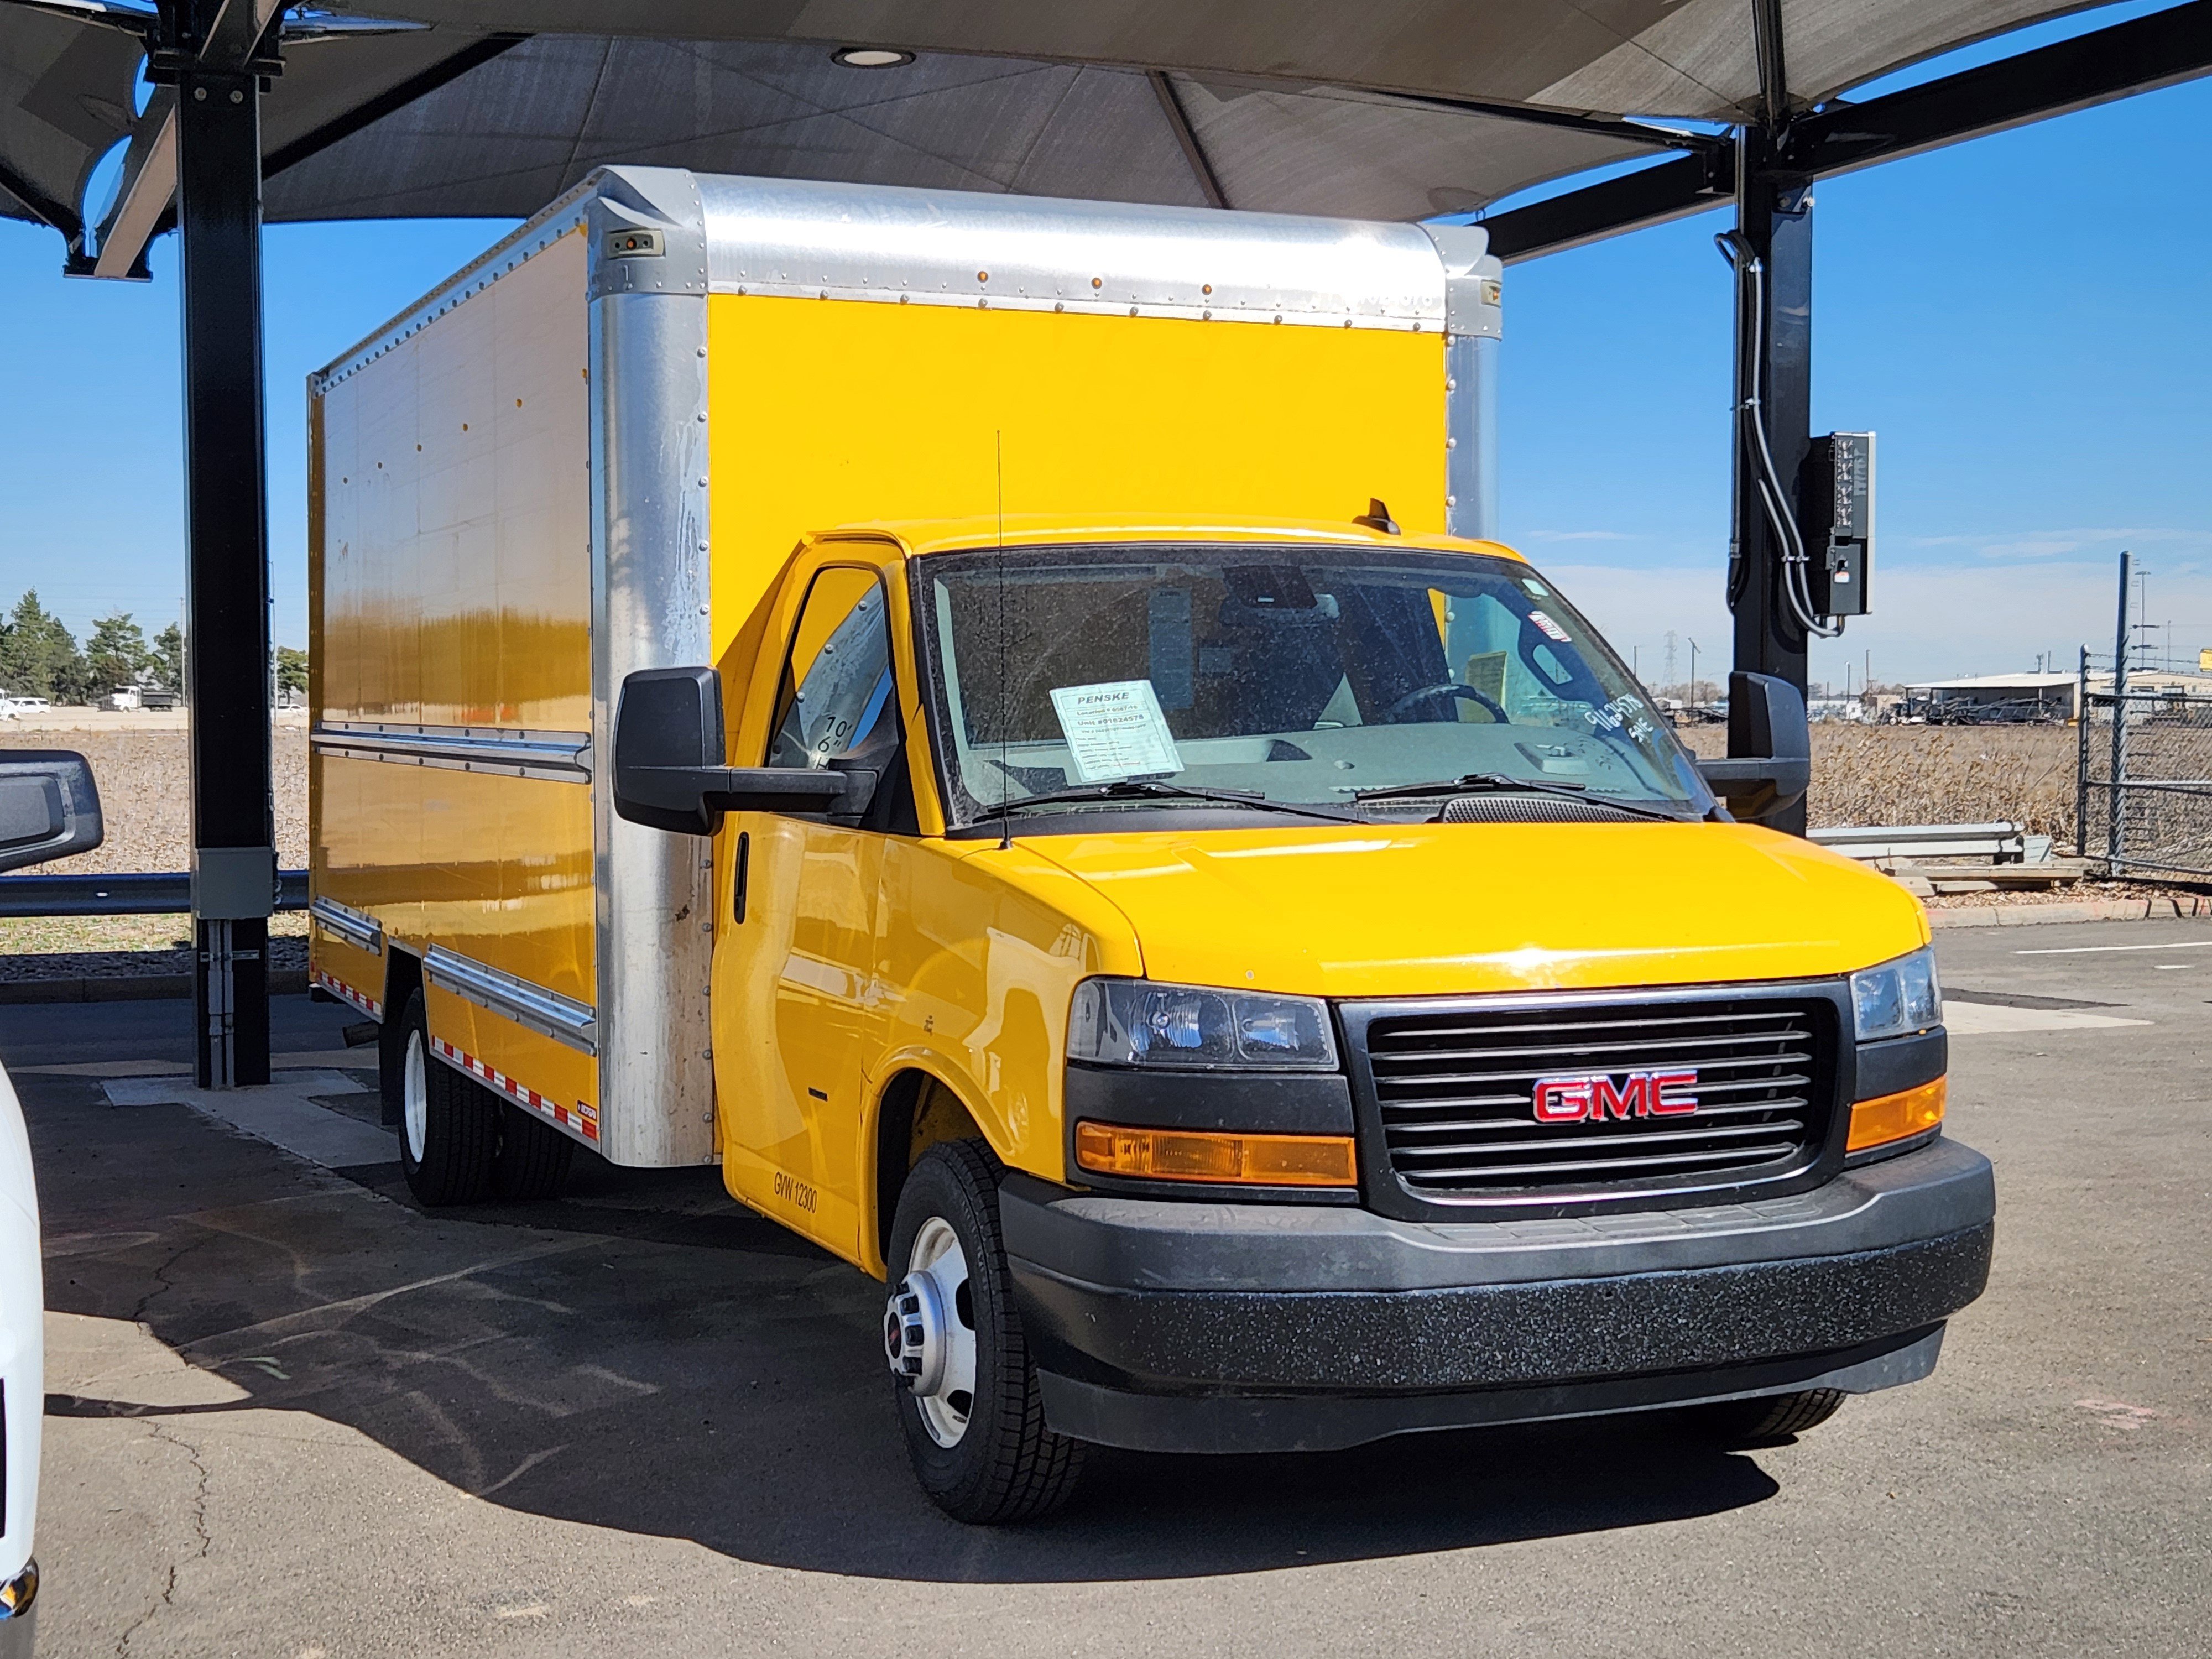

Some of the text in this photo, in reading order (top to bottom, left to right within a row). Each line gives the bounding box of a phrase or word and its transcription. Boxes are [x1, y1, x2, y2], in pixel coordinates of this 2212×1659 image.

[1078, 692, 1129, 705] PENSKE
[1533, 1068, 1699, 1123] GMC
[774, 1171, 817, 1214] GVW 12300
